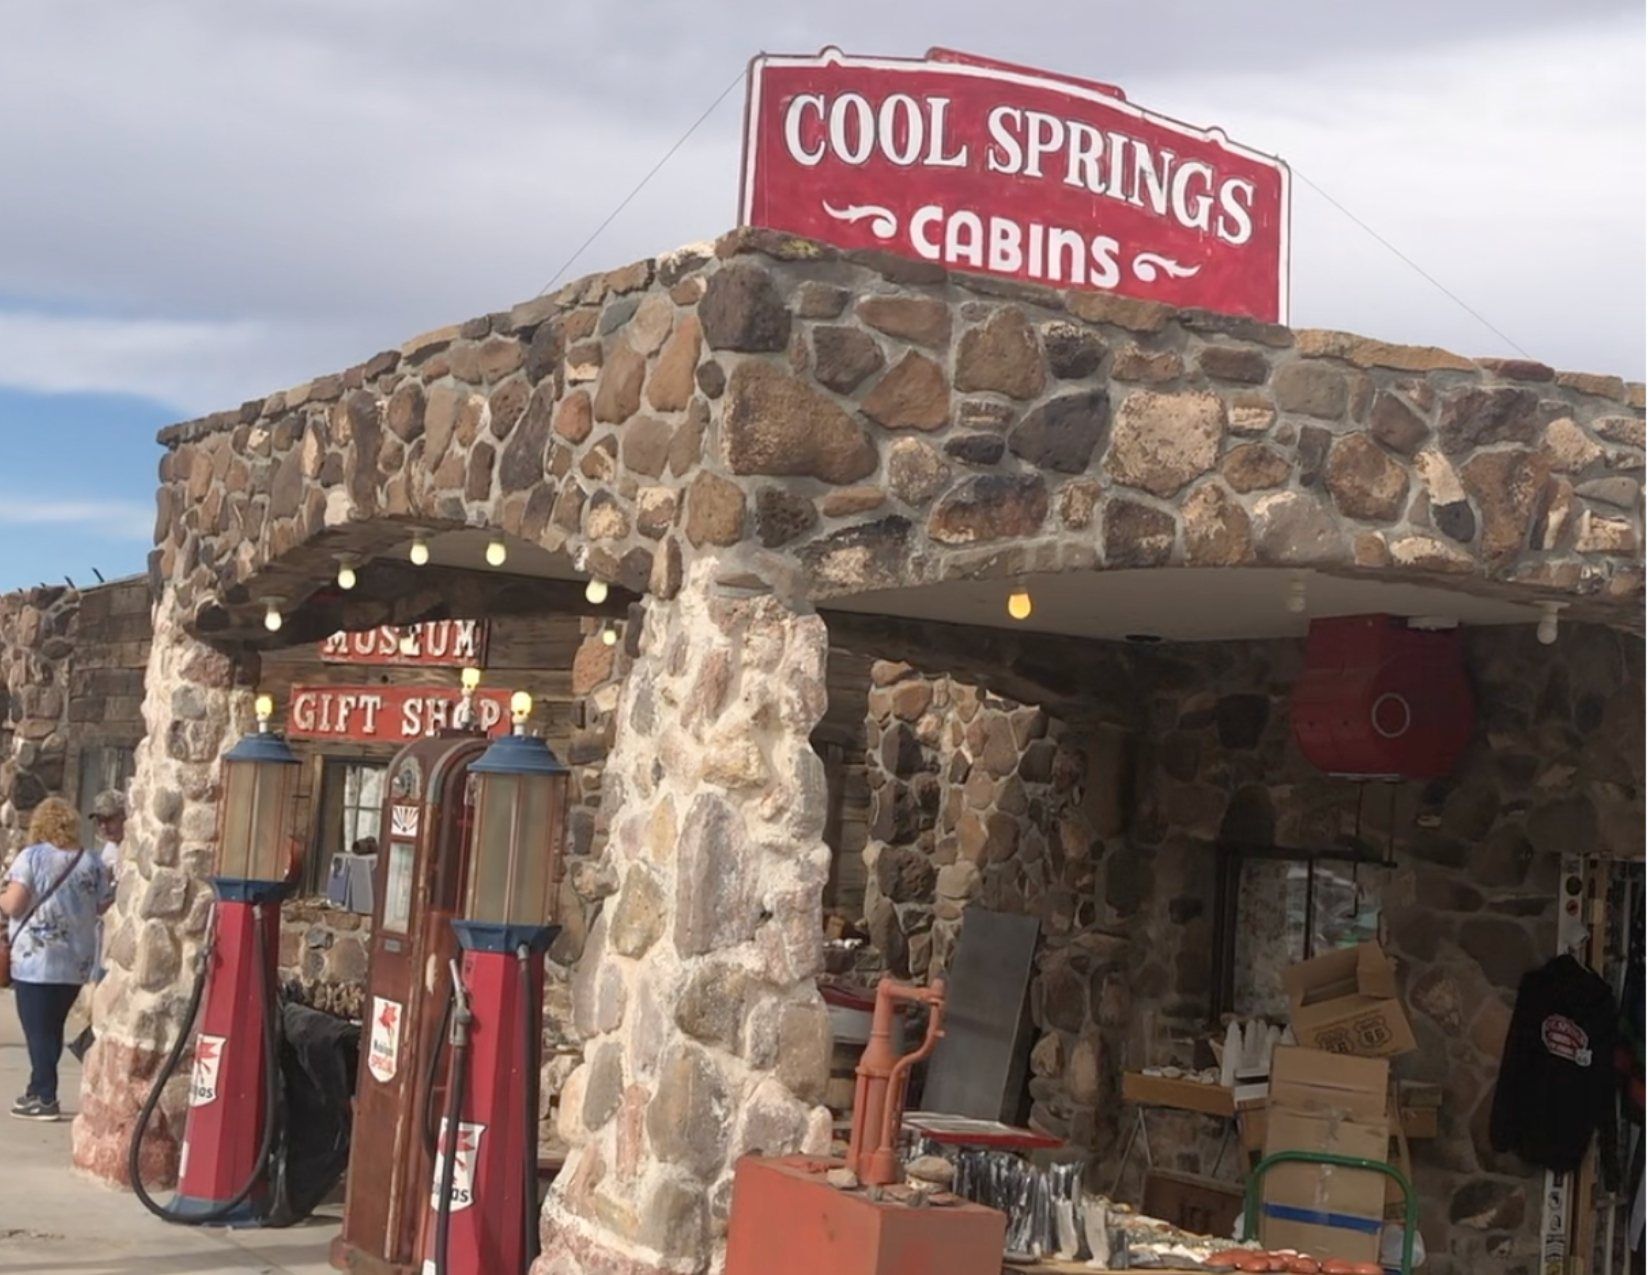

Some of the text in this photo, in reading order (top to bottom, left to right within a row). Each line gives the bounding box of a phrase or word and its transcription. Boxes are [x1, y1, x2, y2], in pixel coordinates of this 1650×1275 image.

[784, 92, 1255, 245] COOL SPRINGS
[293, 692, 382, 734] GIFT
